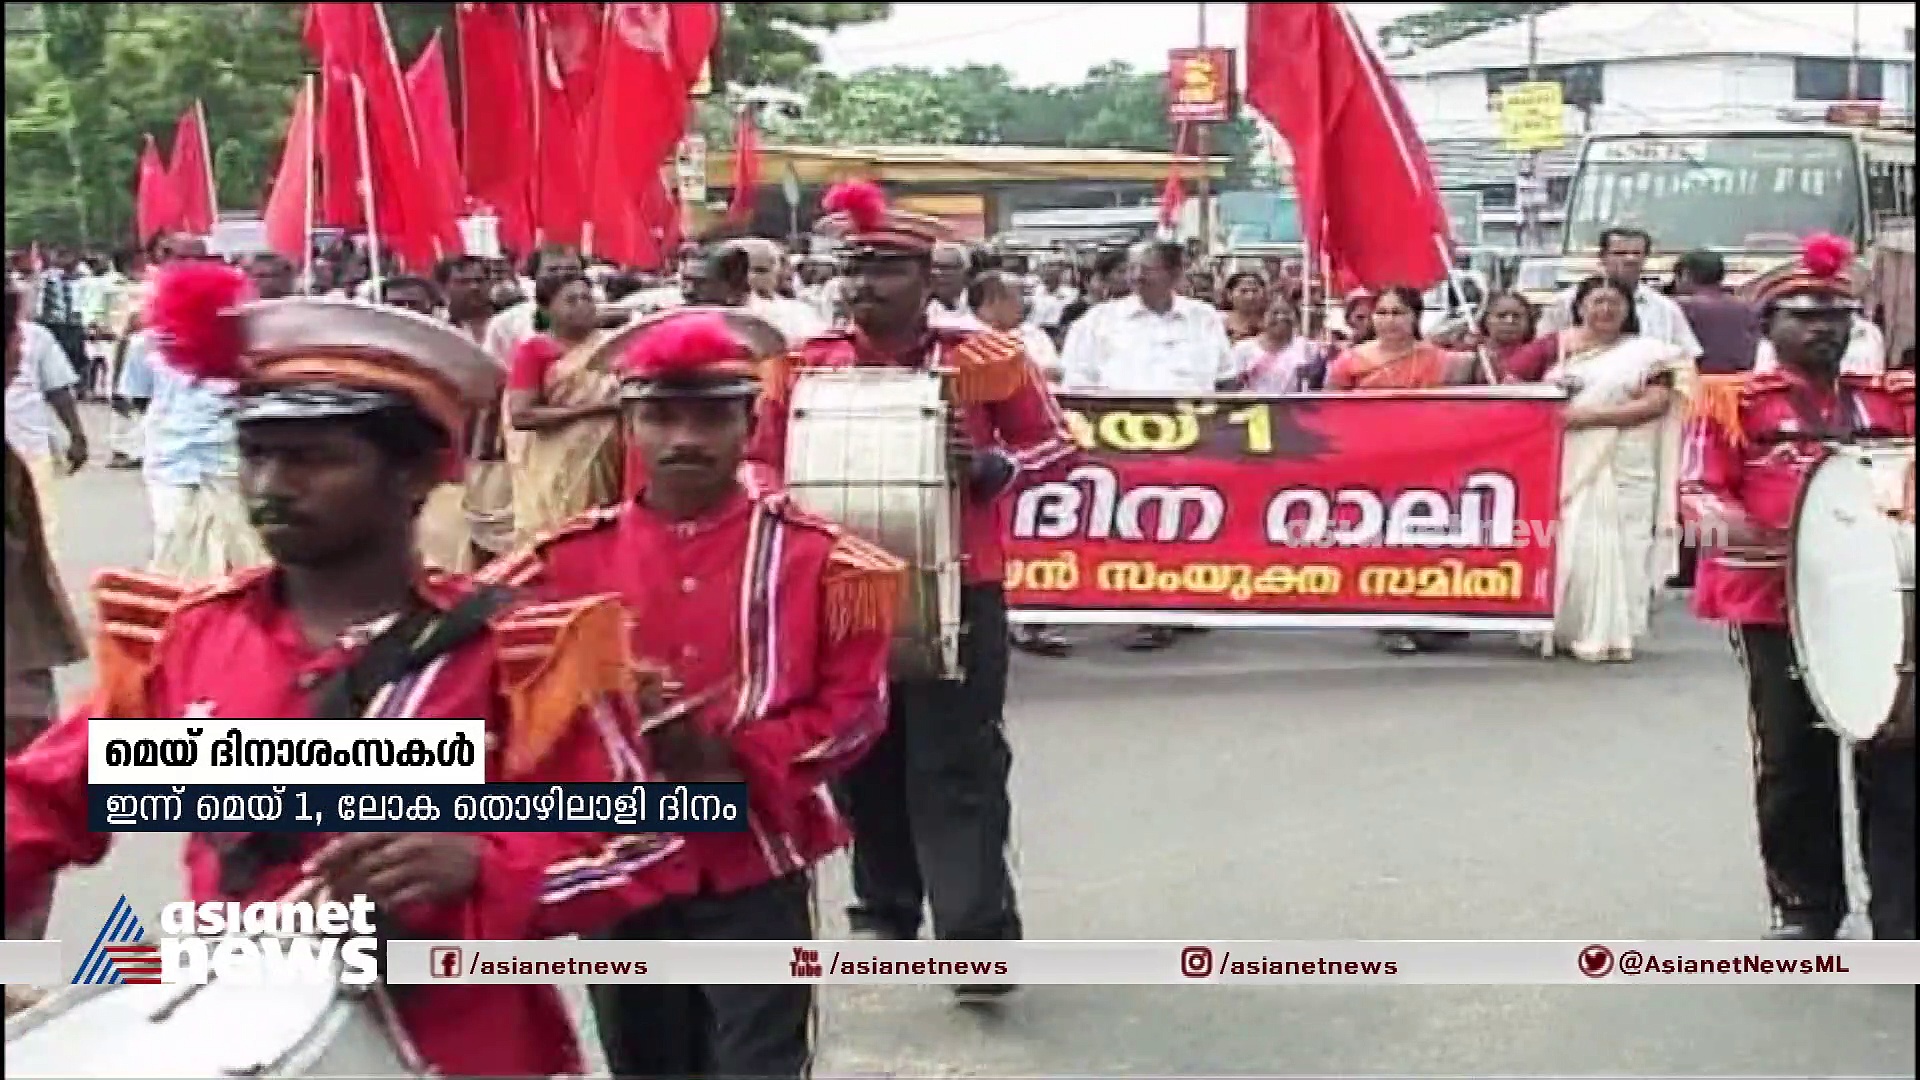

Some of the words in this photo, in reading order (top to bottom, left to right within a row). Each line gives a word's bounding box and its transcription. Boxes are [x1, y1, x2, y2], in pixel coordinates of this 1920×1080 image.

[1228, 404, 1274, 453] 1
[1013, 464, 1226, 542] ദിന
[1266, 472, 1516, 548] റാലി
[1096, 560, 1343, 602] സംയുക്ത
[1358, 557, 1523, 600] സമിതി
